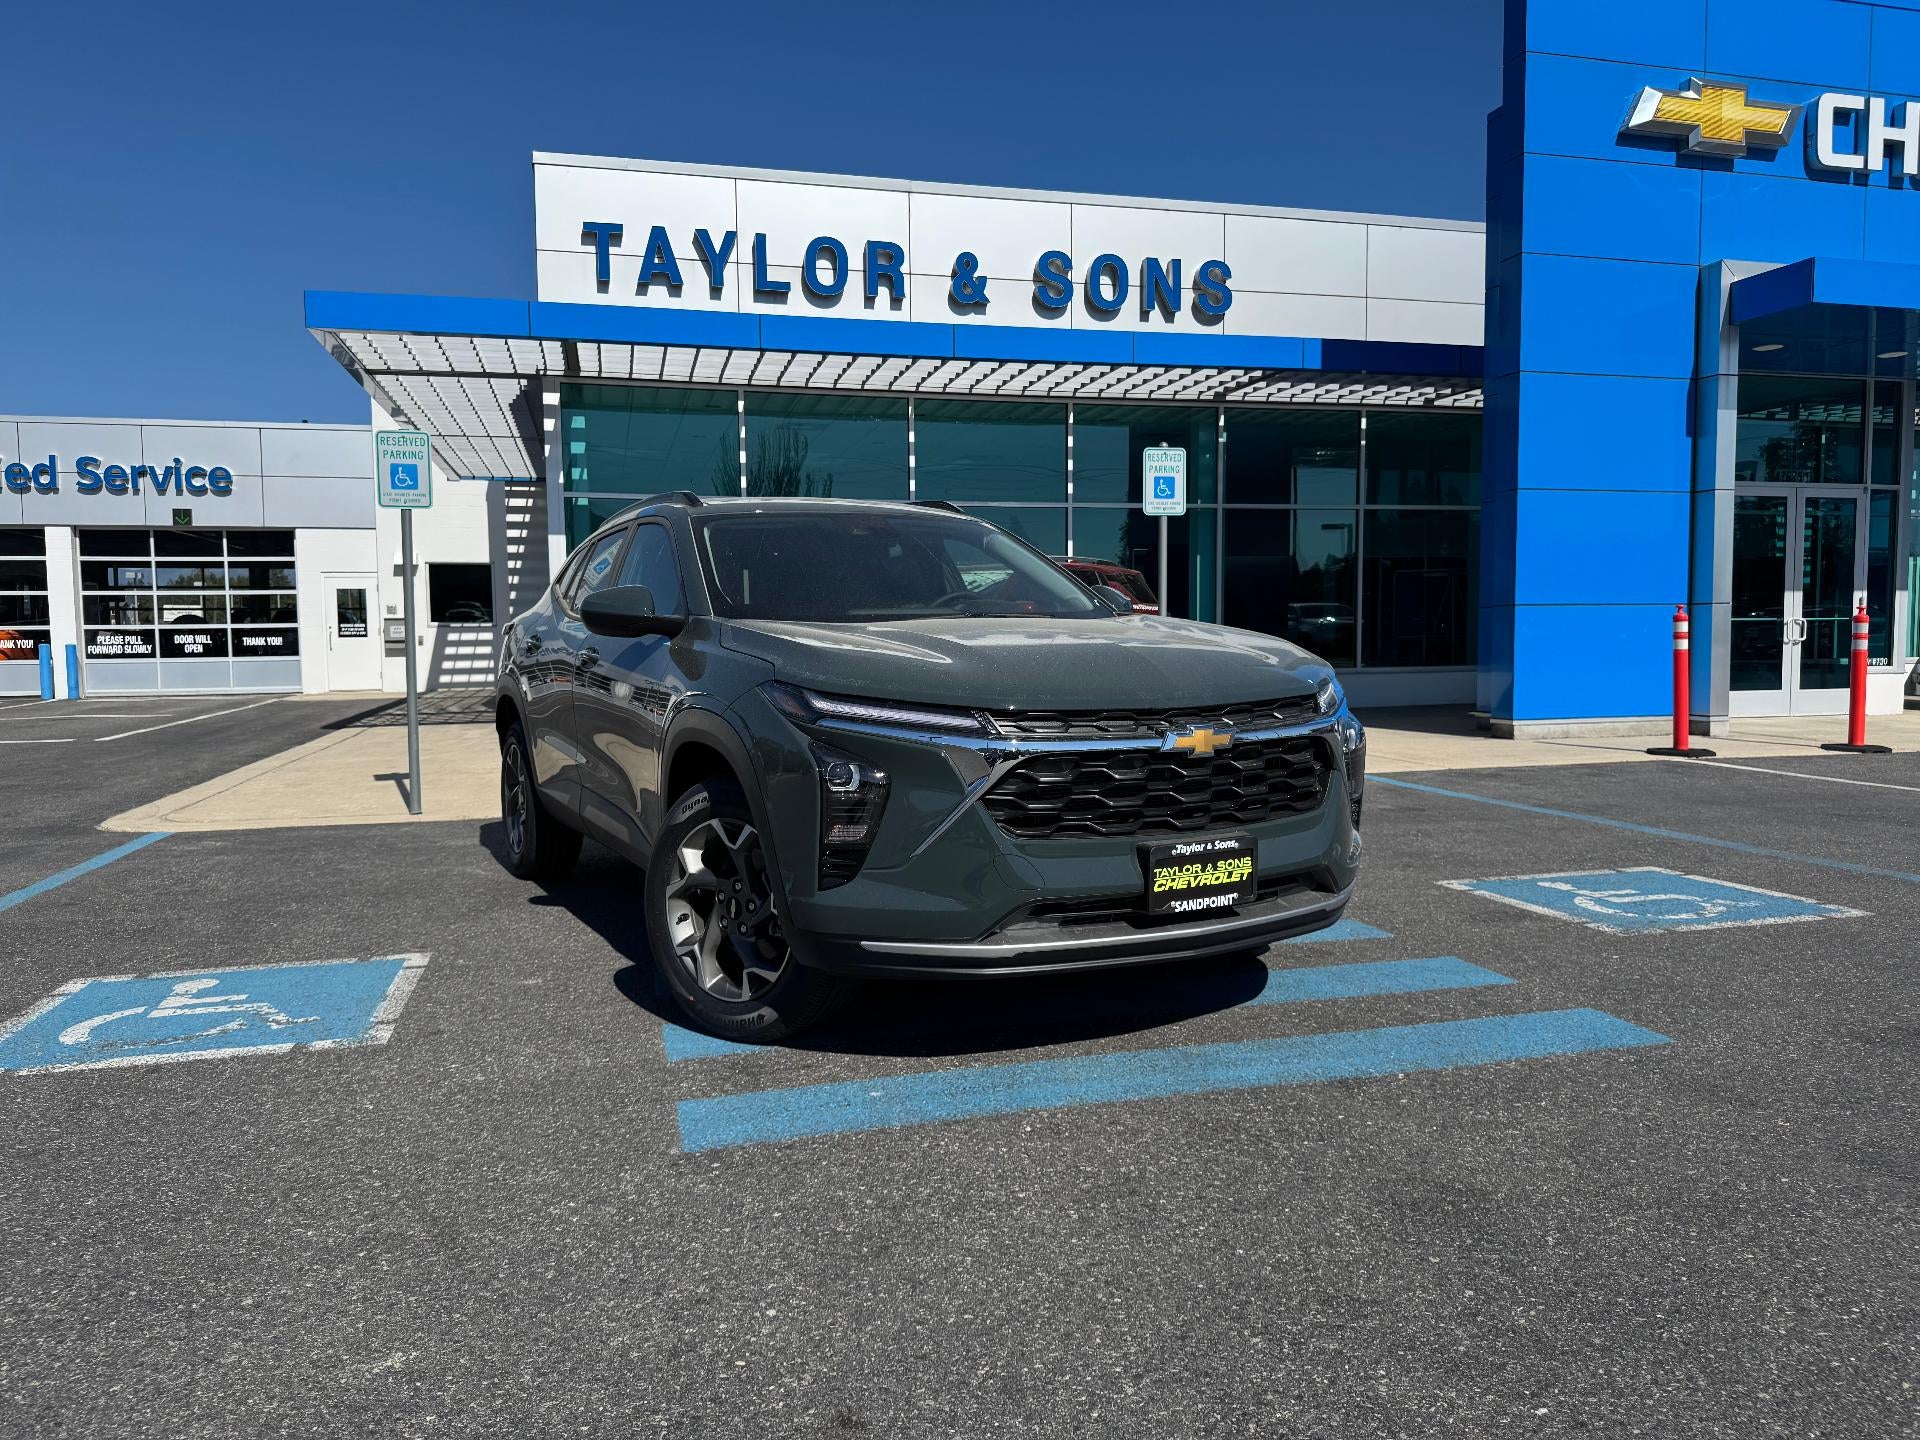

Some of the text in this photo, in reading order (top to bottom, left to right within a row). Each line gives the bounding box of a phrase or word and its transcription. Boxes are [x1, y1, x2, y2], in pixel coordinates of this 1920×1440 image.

[1816, 92, 1919, 174] CH
[581, 221, 1232, 316] TAYLOR & SONS
[380, 436, 426, 447] RESERVED
[383, 450, 424, 460] PARKING
[1147, 453, 1182, 463] RESERVED
[0, 455, 233, 491] ed Service
[1149, 465, 1180, 474] PARKING
[16, 639, 34, 649] YOU!
[97, 635, 142, 645] PLEASE PULL
[174, 635, 212, 644] DOOR WILL
[243, 637, 283, 646] THANK YOU!
[88, 645, 152, 654] FORWARD SLOWLY
[185, 644, 203, 653] OPEN
[1176, 843, 1205, 855] Taylor
[1214, 840, 1236, 849] Sons
[1154, 857, 1251, 879] TAYLOR & SONS
[1154, 869, 1252, 892] CHEVROLET
[1175, 894, 1234, 912] SANDPOINT
